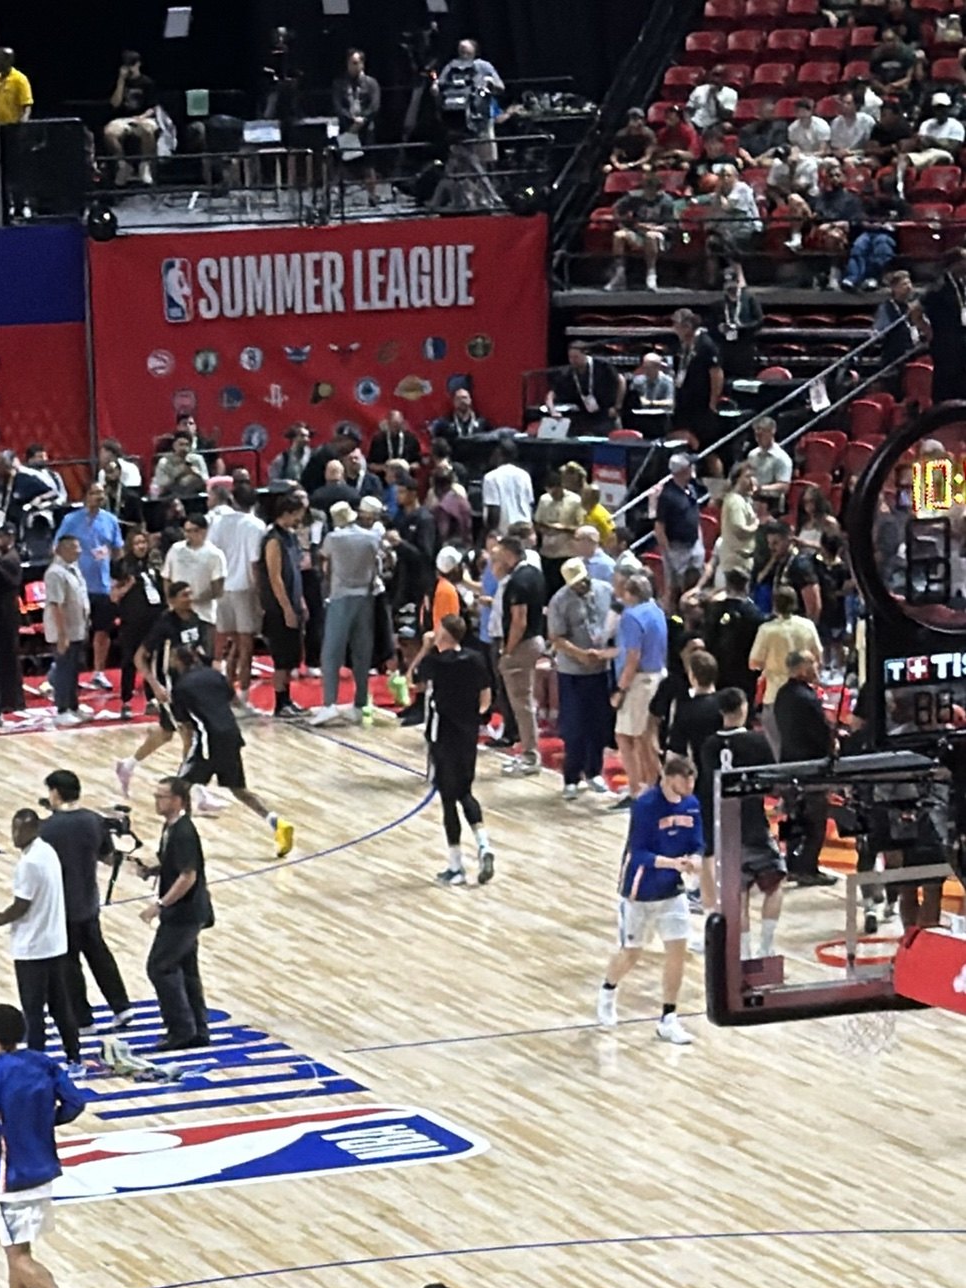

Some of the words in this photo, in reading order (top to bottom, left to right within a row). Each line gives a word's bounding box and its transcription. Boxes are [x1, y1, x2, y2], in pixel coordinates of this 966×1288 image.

[197, 249, 345, 319] SUMMER
[353, 244, 475, 311] LEAGUE
[913, 458, 966, 512] 10:
[320, 1123, 449, 1160] NBA
